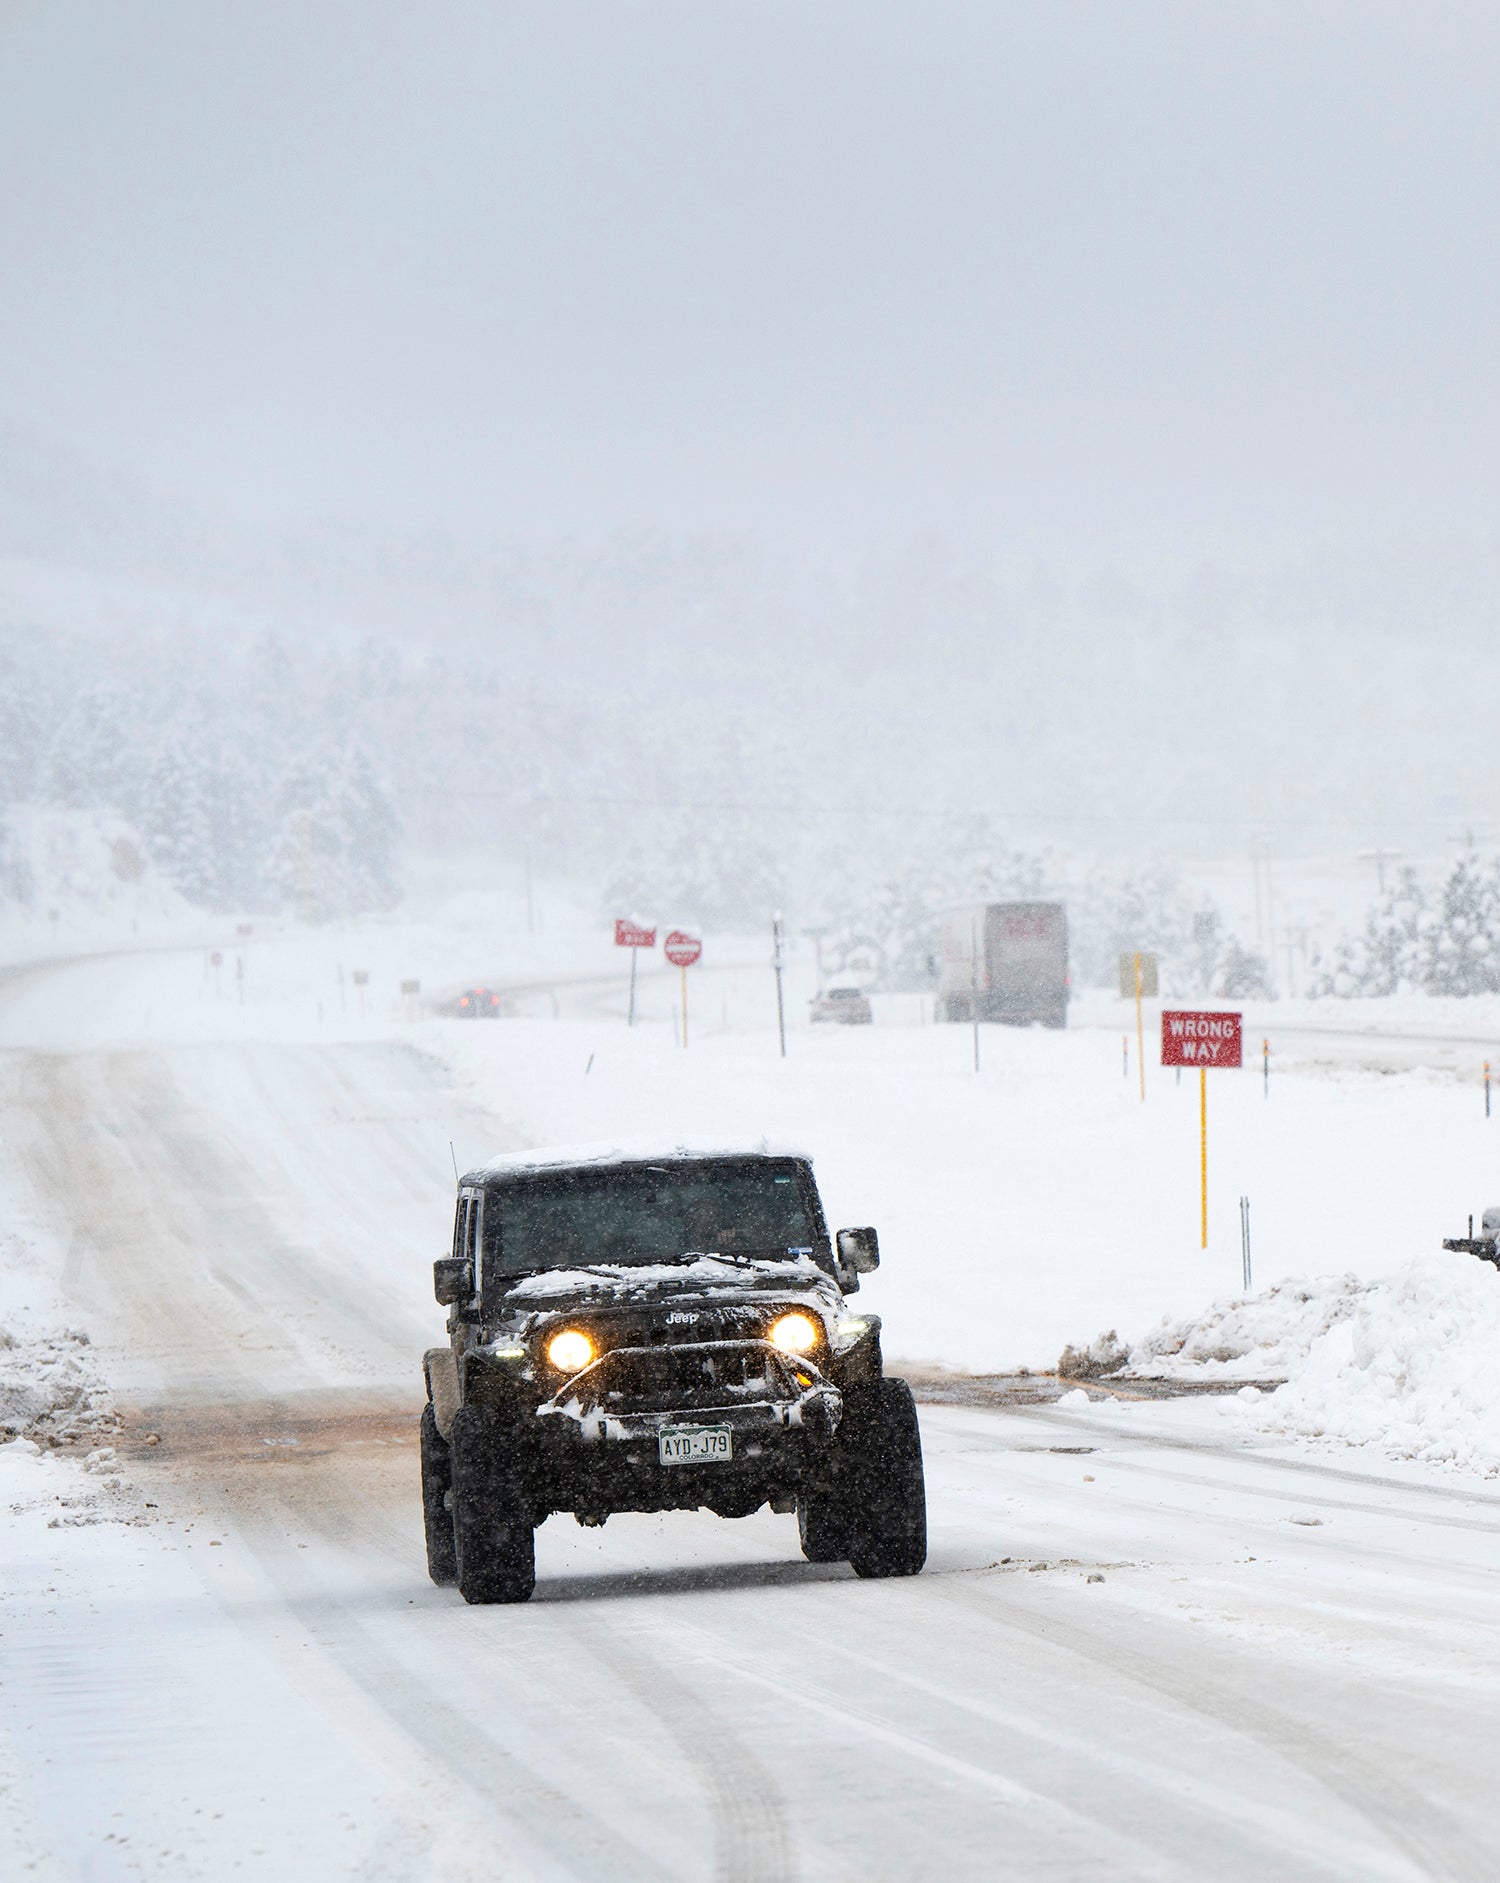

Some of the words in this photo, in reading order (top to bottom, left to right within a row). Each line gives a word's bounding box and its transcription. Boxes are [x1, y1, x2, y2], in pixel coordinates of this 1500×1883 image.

[1169, 1020, 1234, 1038] WRONG
[1182, 1041, 1221, 1060] WAY
[665, 1311, 699, 1325] Jeep
